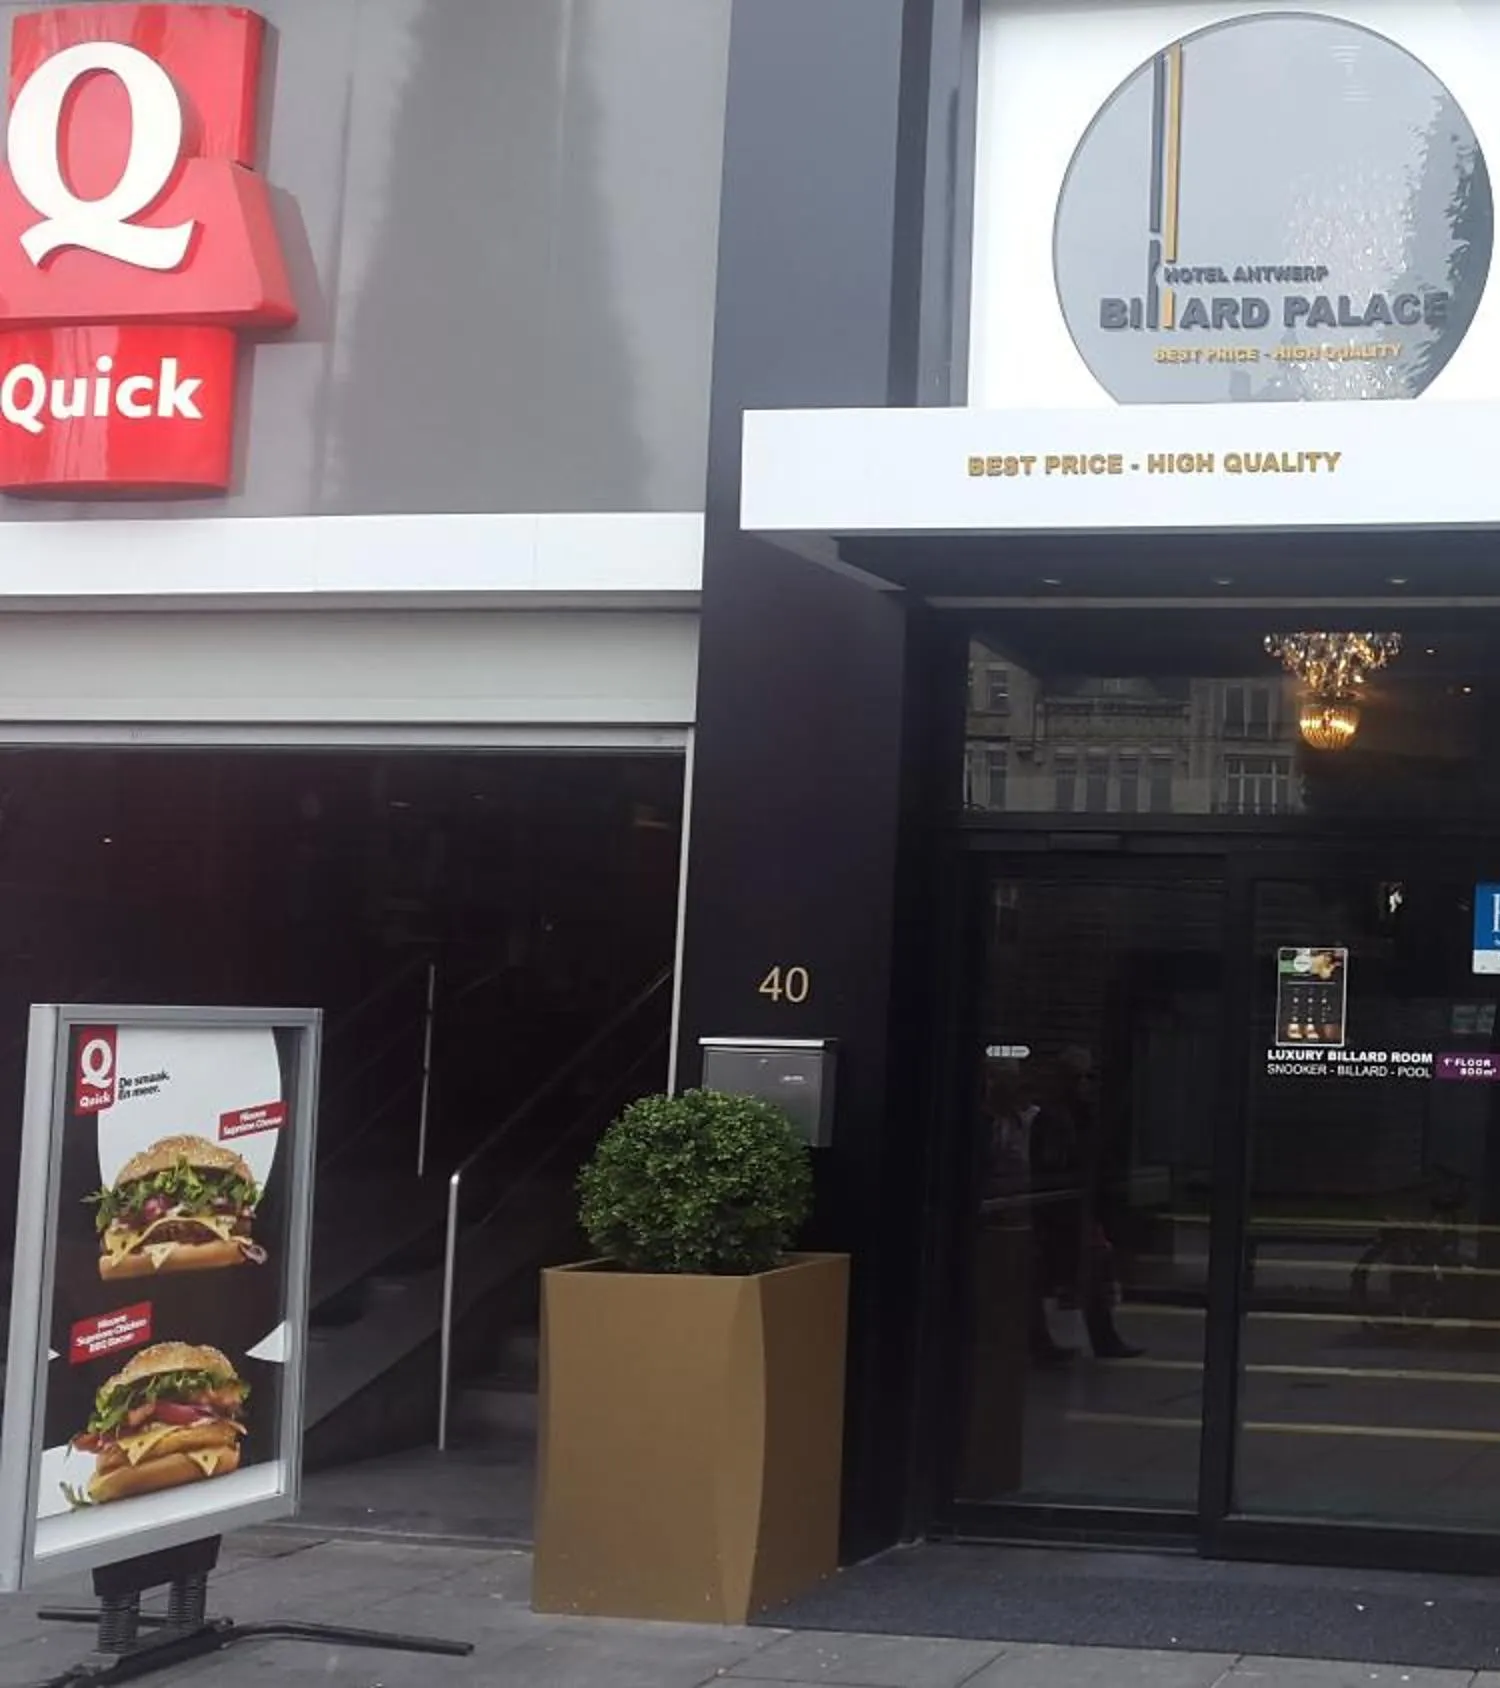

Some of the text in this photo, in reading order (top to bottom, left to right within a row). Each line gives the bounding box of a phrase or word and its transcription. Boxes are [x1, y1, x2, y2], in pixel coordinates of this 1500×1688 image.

[7, 41, 195, 270] Q
[1233, 265, 1329, 284] ANTWERP
[1282, 291, 1450, 329] PALACE
[1205, 346, 1260, 364] PRICE
[0, 356, 203, 435] Quick
[967, 456, 1037, 477] BEST
[1044, 454, 1124, 476] PRICE
[1147, 453, 1215, 474] HIGH
[1223, 451, 1342, 474] QUALITY
[758, 965, 810, 1003] 40
[81, 1039, 113, 1089] Q
[1267, 1049, 1433, 1064] LUXURY BILLARD ROOM
[1455, 1058, 1491, 1067] FLOOR
[1267, 1063, 1327, 1076] SNOOKER
[1337, 1065, 1388, 1077] BILLARD
[1398, 1066, 1432, 1079] POOL
[79, 1092, 112, 1108] Quick
